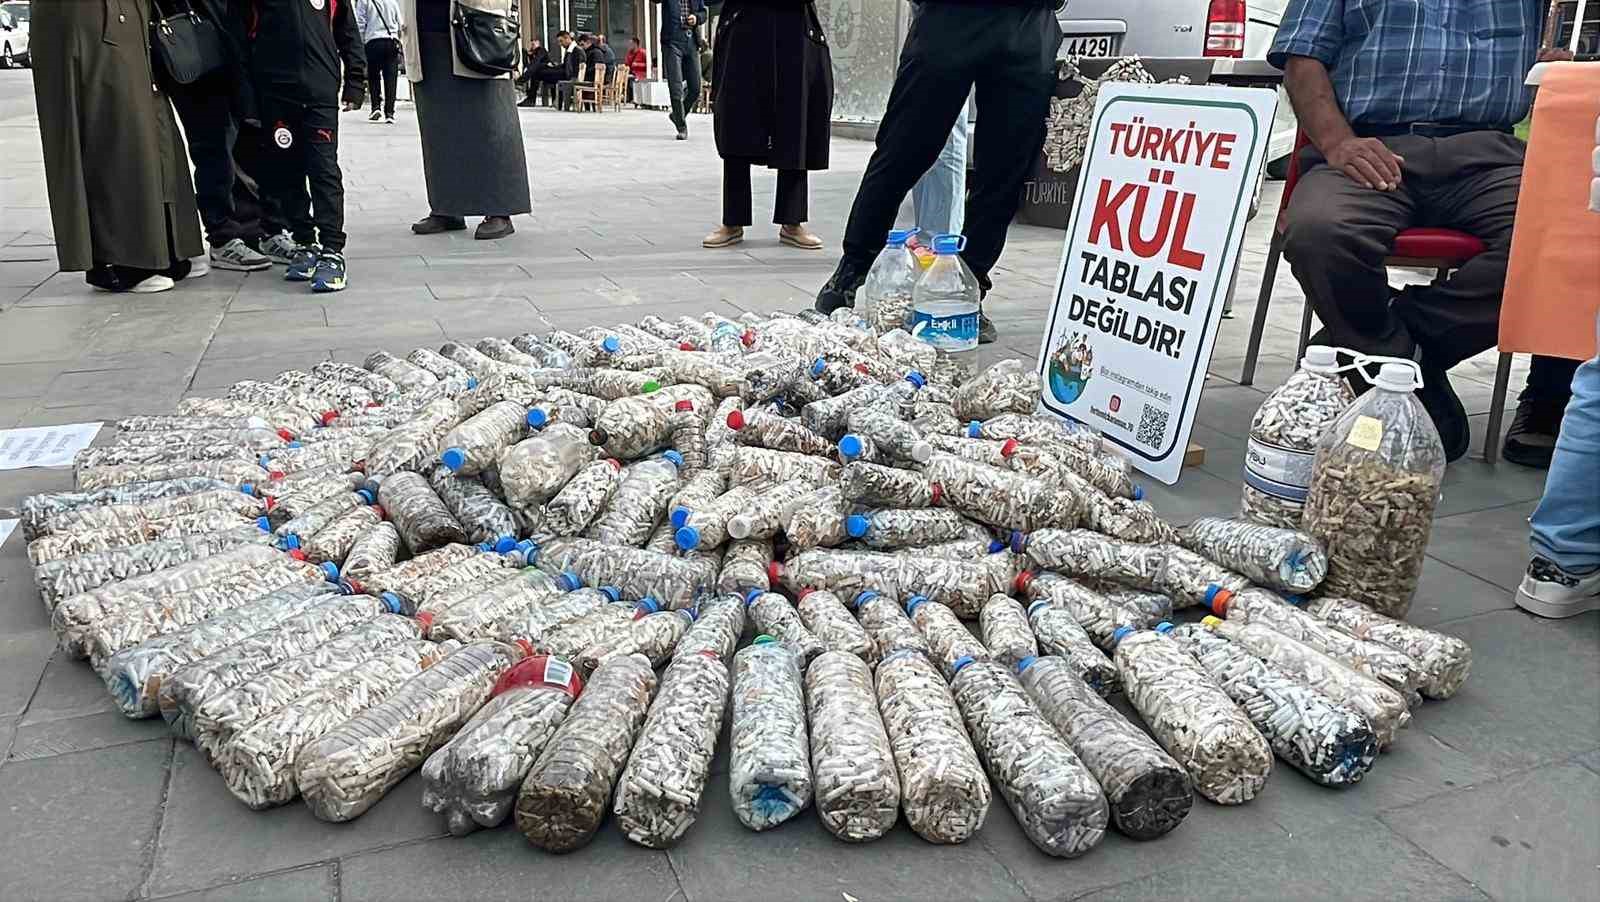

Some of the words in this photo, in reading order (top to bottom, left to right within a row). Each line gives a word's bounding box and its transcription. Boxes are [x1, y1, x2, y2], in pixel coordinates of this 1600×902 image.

[1067, 38, 1108, 57] 4429
[1110, 116, 1237, 170] TÜRKİYE
[1088, 168, 1205, 271] KÜL
[1081, 251, 1198, 315] TABLASI
